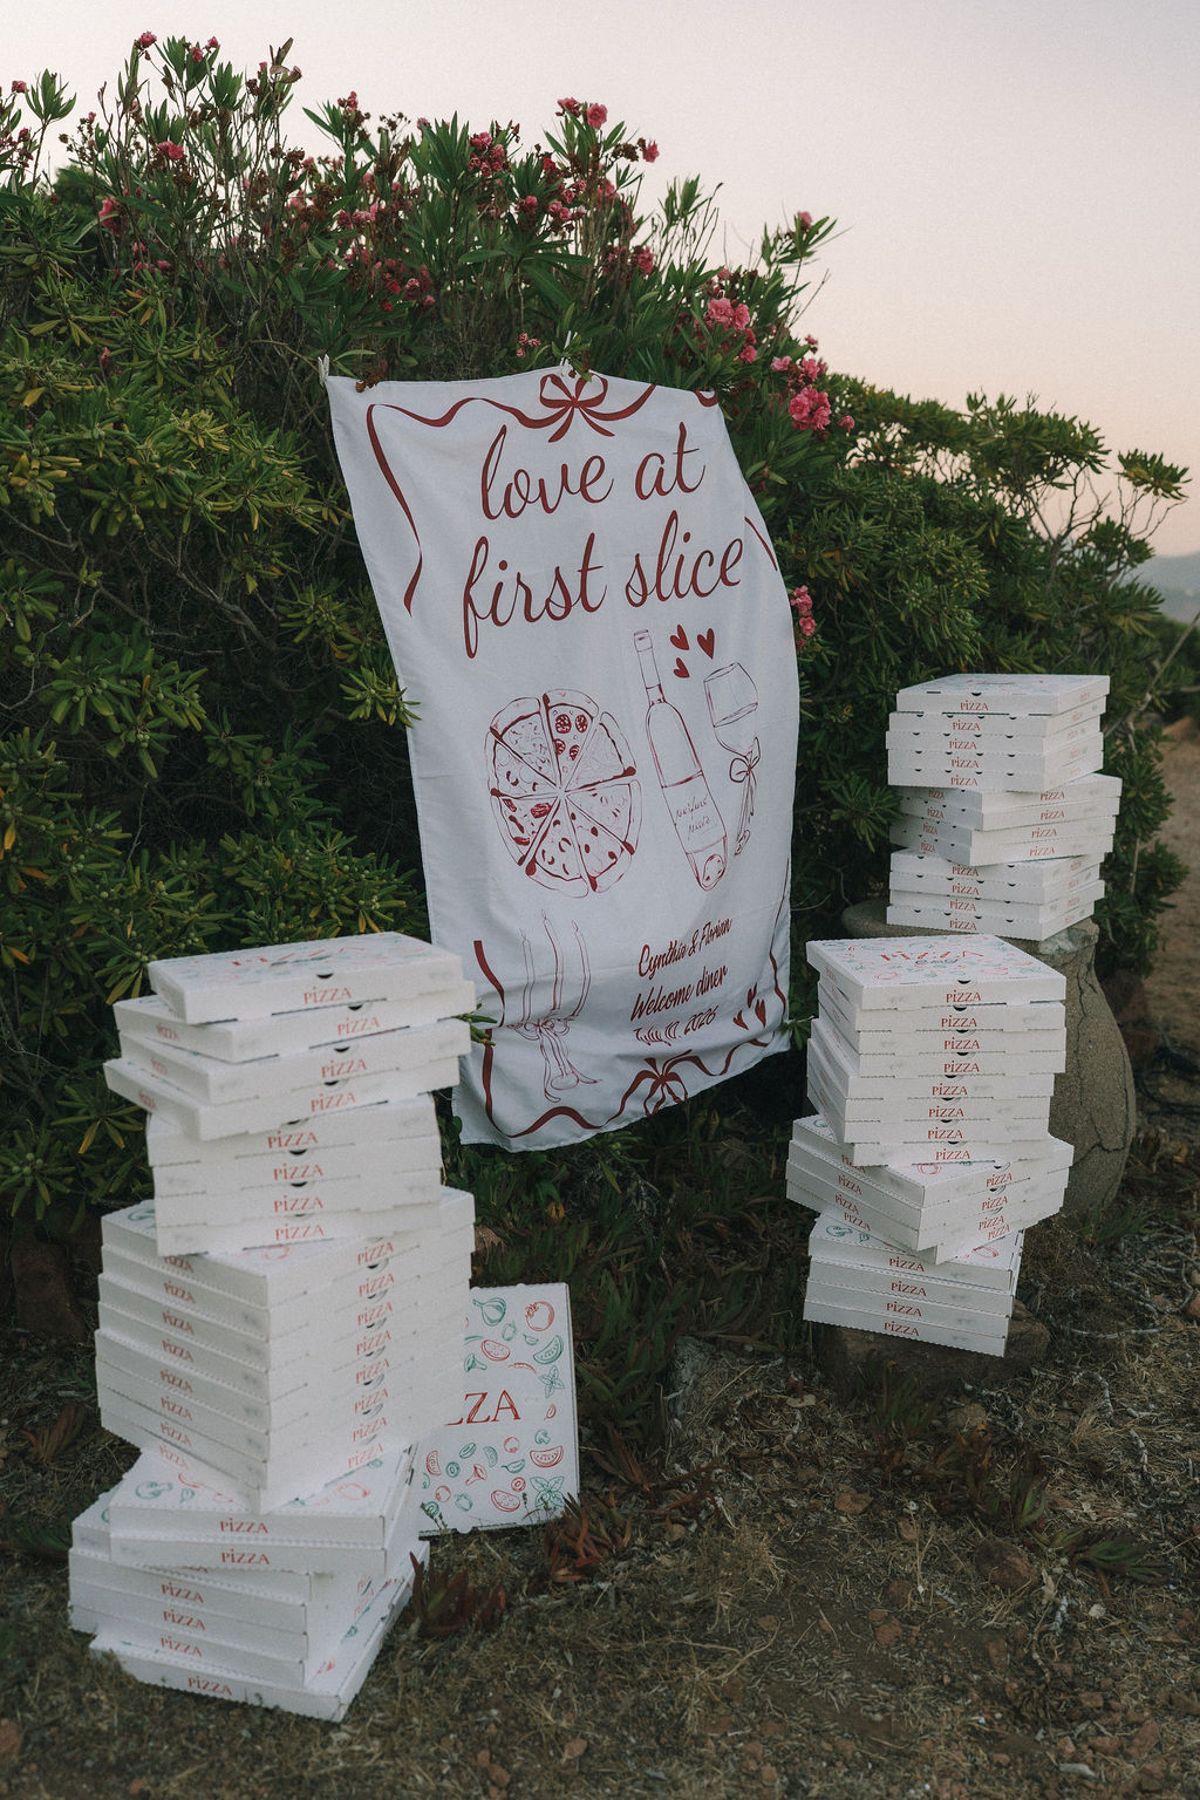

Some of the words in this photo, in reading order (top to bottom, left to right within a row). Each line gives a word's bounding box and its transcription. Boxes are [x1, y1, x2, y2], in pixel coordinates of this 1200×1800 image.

[482, 424, 614, 520] love
[635, 422, 706, 500] at
[463, 533, 607, 658] first
[626, 510, 743, 607] slice
[960, 700, 989, 712] PiZZA
[952, 720, 981, 731] PiZZA
[949, 738, 977, 750] PiZZA
[951, 758, 979, 769] PiZZA
[951, 775, 978, 786] PiZZA
[1040, 789, 1065, 800] PiZZA
[1040, 809, 1065, 820] PiZZA
[1031, 827, 1057, 838] PiZZA
[1029, 845, 1055, 856] PiZZA
[952, 864, 979, 877] PiZZA
[952, 882, 979, 895] PiZZA
[950, 899, 976, 912] PiZZA
[950, 918, 976, 930] PiZZA
[639, 940, 686, 980] Cynthia
[688, 929, 699, 956] &
[700, 918, 732, 951] Florian
[303, 986, 353, 1004] PiZZA
[630, 983, 694, 1021] Welcome
[946, 990, 982, 1002] PiZZA
[337, 1016, 380, 1035] PiZZA
[684, 1005, 719, 1035] 2026
[941, 1015, 977, 1028] PiZZA
[944, 1038, 980, 1050] PiZZA
[321, 1060, 368, 1078] PiZZA
[944, 1061, 980, 1073] PiZZA
[932, 1084, 968, 1096] PiZZA
[310, 1093, 356, 1112] PiZZA
[929, 1106, 964, 1118] PiZZA
[268, 1130, 318, 1149] PiZZA
[928, 1128, 963, 1140] PiZZA
[936, 1149, 970, 1160] PiZZA
[273, 1163, 324, 1181] PiZZA
[986, 1172, 1013, 1187] PiZZA
[838, 1173, 863, 1196] PiZZA
[273, 1196, 324, 1213] PiZZA
[835, 1192, 860, 1215] PiZZA
[982, 1195, 1008, 1210] PiZZA
[844, 1210, 871, 1231] PiZZA
[978, 1215, 1004, 1231] PiZZA
[275, 1225, 325, 1241] PiZZA
[357, 1242, 394, 1264] PiZZA
[889, 1256, 925, 1272] PiZZA
[358, 1272, 394, 1294] PiZZA
[891, 1281, 927, 1296] PiZZA
[358, 1302, 394, 1324] PiZZA
[886, 1301, 922, 1317] PiZZA
[884, 1320, 920, 1336] PiZZA
[356, 1330, 392, 1353] PiZZA
[356, 1359, 390, 1382] PiZZA
[354, 1388, 389, 1411] PiZZA
[352, 1417, 389, 1439] PiZZA
[347, 1444, 384, 1466] PiZZA
[220, 1518, 269, 1534] PiZZA
[221, 1549, 270, 1565] PiZZA
[161, 1582, 205, 1604] PiZZA
[163, 1609, 206, 1631] PiZZA
[160, 1637, 204, 1657] PiZZA
[187, 1676, 233, 1696] PiZZA
